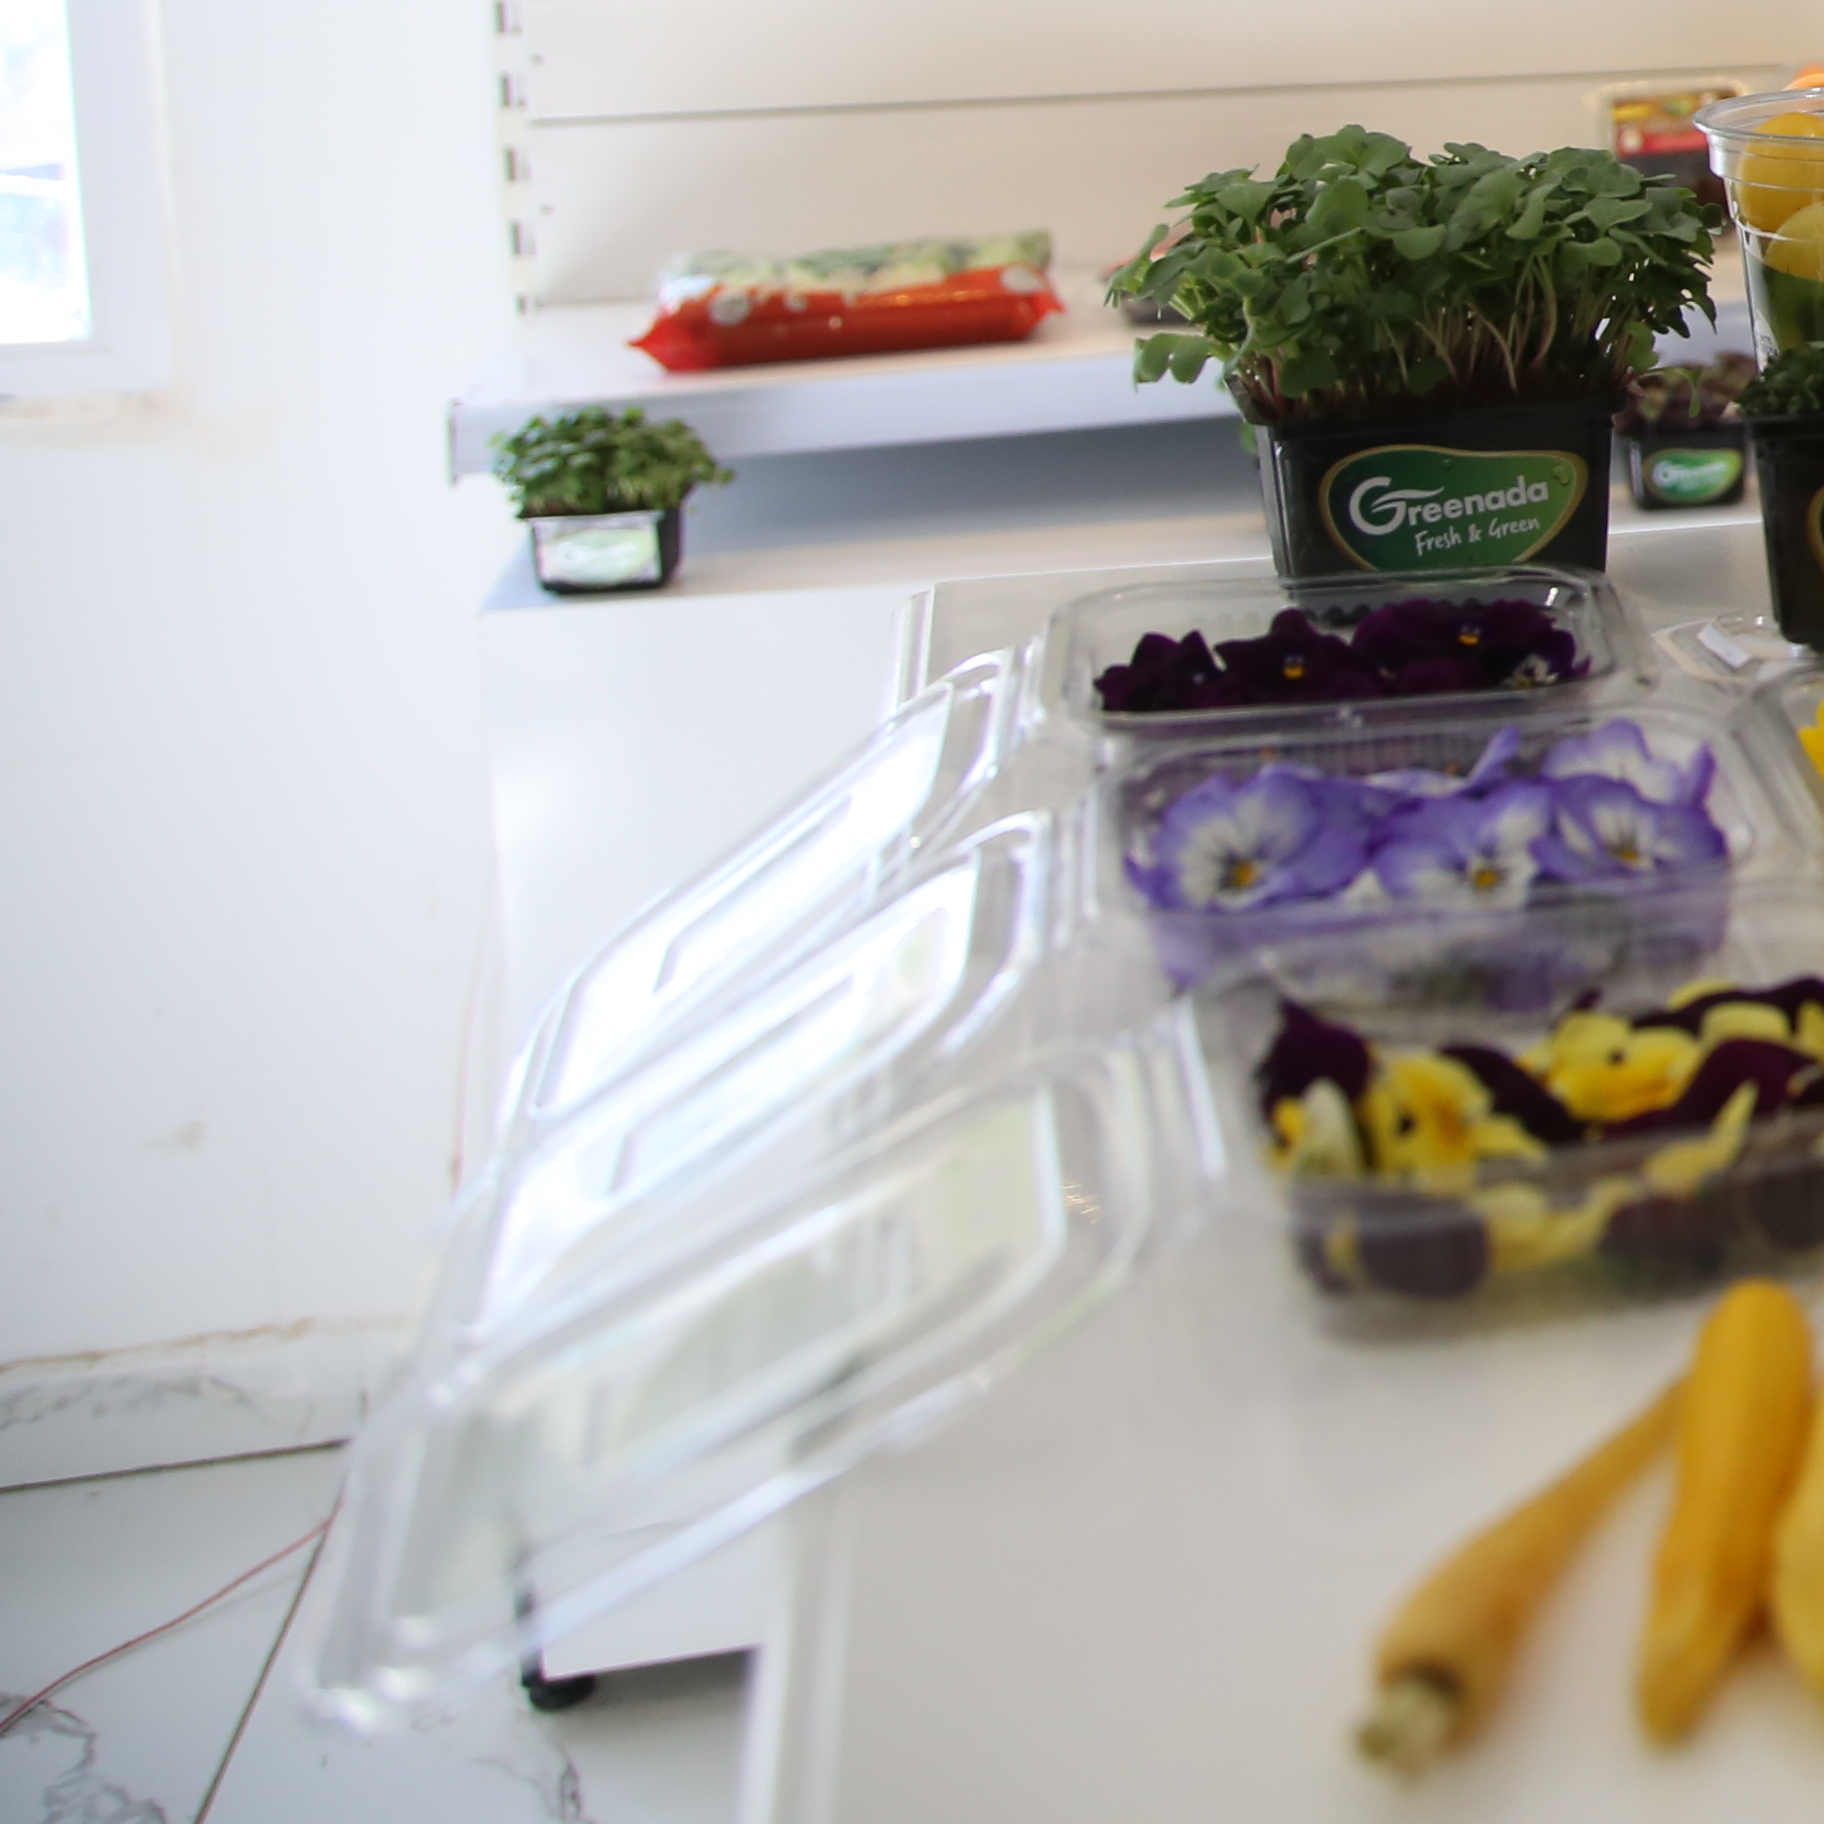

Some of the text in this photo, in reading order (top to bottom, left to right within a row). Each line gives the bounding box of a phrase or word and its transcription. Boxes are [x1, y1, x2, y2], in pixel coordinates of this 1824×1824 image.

[1348, 475, 1549, 536] Greenada
[1414, 517, 1541, 557] Fresh & Green
